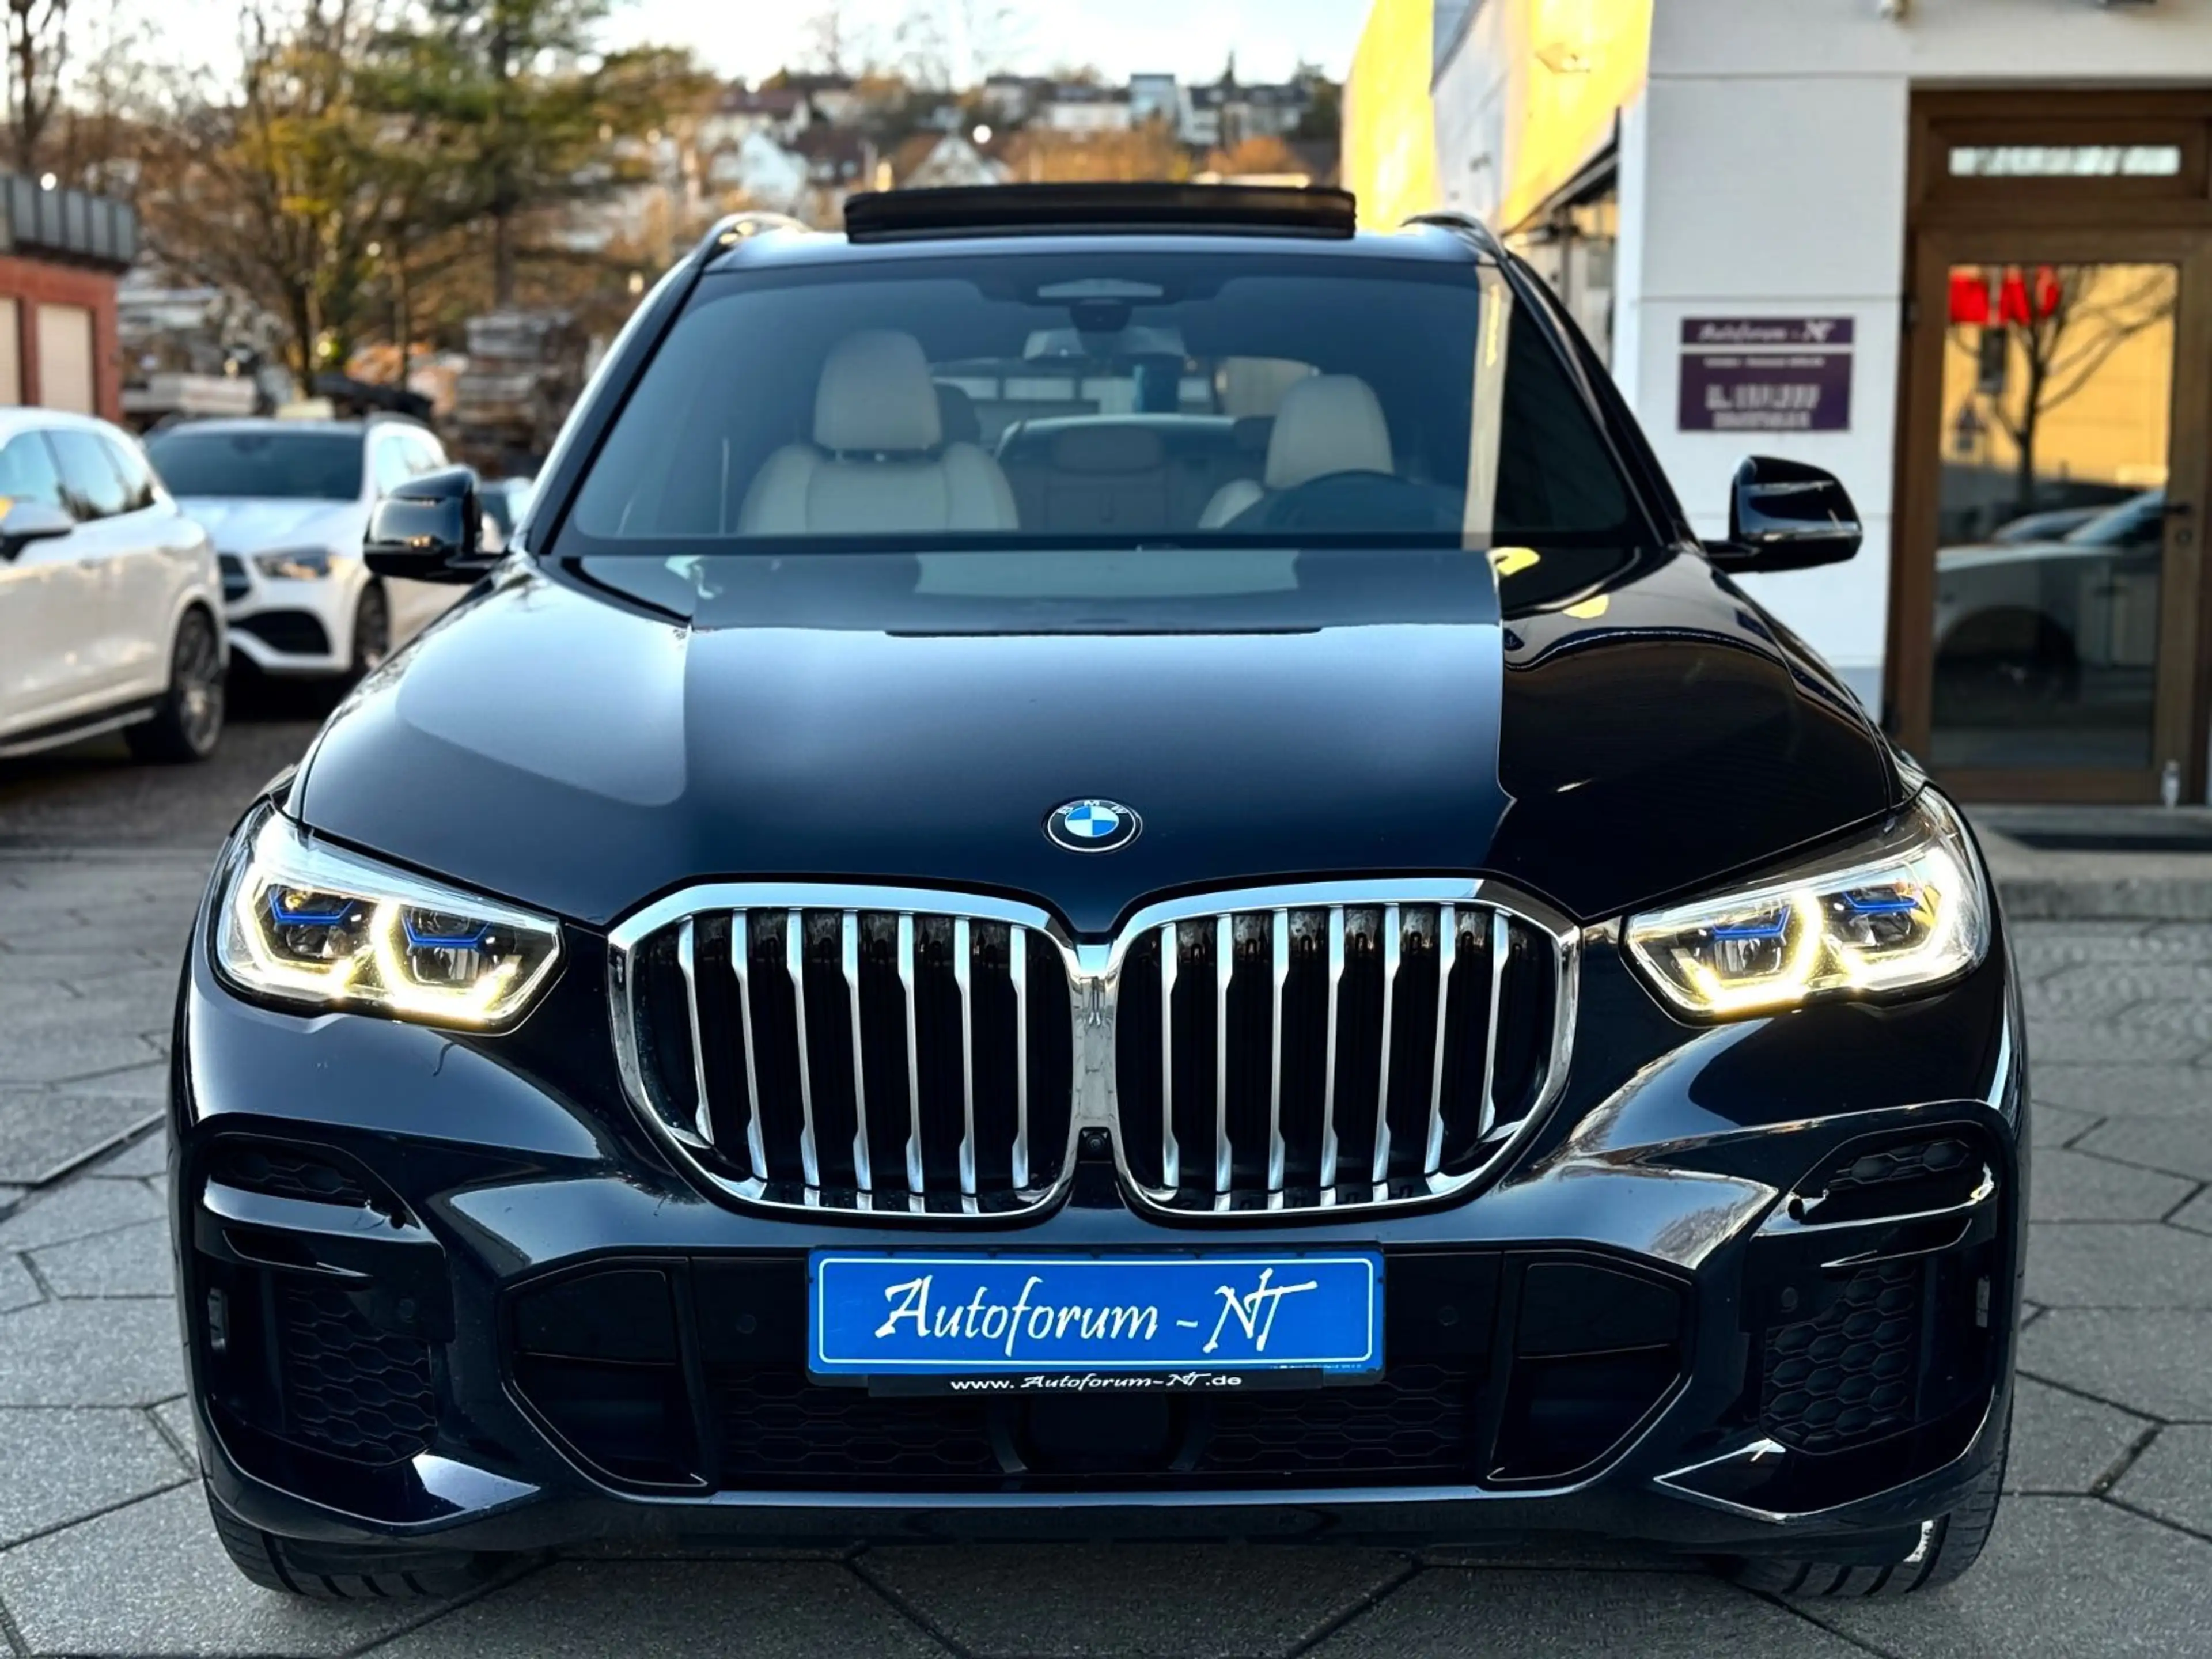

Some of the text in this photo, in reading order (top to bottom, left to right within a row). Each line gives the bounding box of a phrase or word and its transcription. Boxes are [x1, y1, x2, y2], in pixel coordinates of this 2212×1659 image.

[1057, 799, 1128, 815] BMW
[874, 1274, 1158, 1357] Autoforum
[1202, 1267, 1317, 1353] NT
